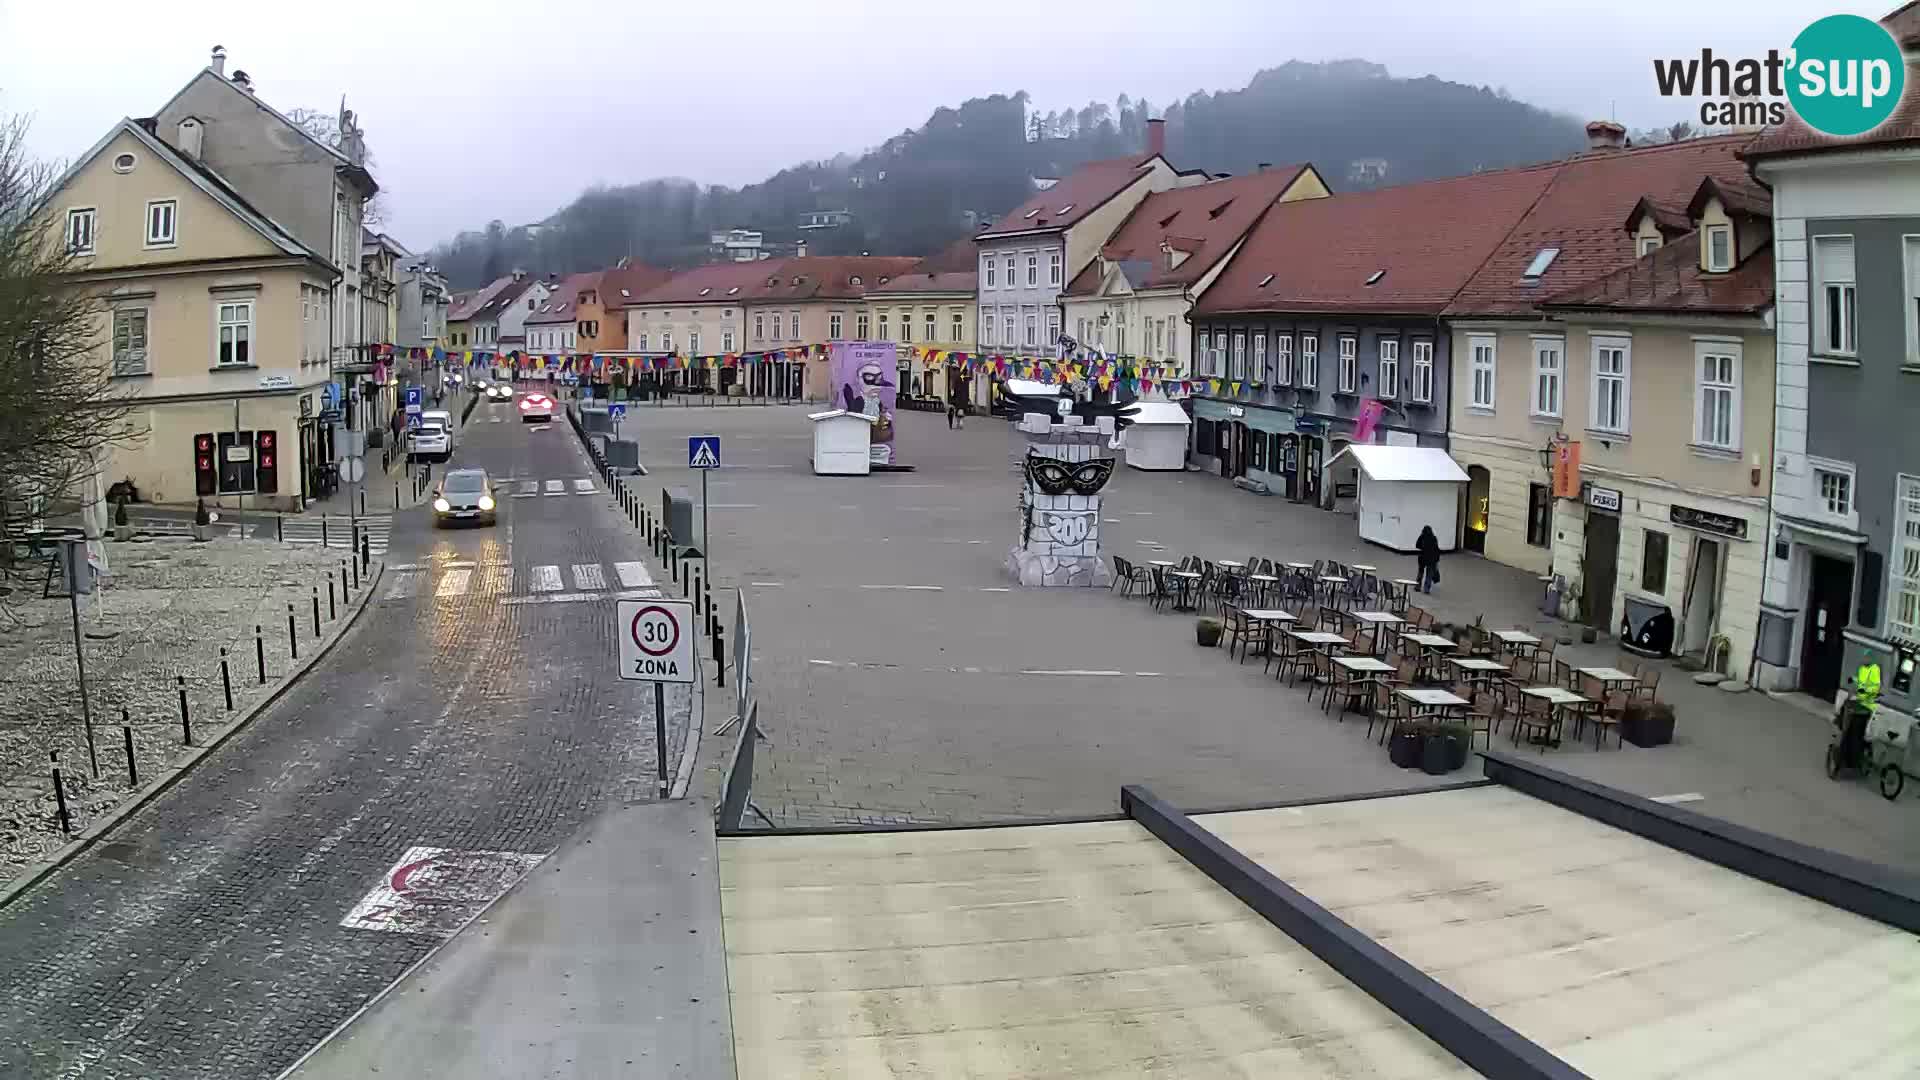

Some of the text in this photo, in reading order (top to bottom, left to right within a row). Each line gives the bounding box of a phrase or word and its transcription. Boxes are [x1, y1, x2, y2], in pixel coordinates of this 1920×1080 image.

[409, 391, 417, 402] P
[1048, 516, 1087, 545] 200
[644, 621, 668, 643] 30
[635, 659, 678, 676] ZONA
